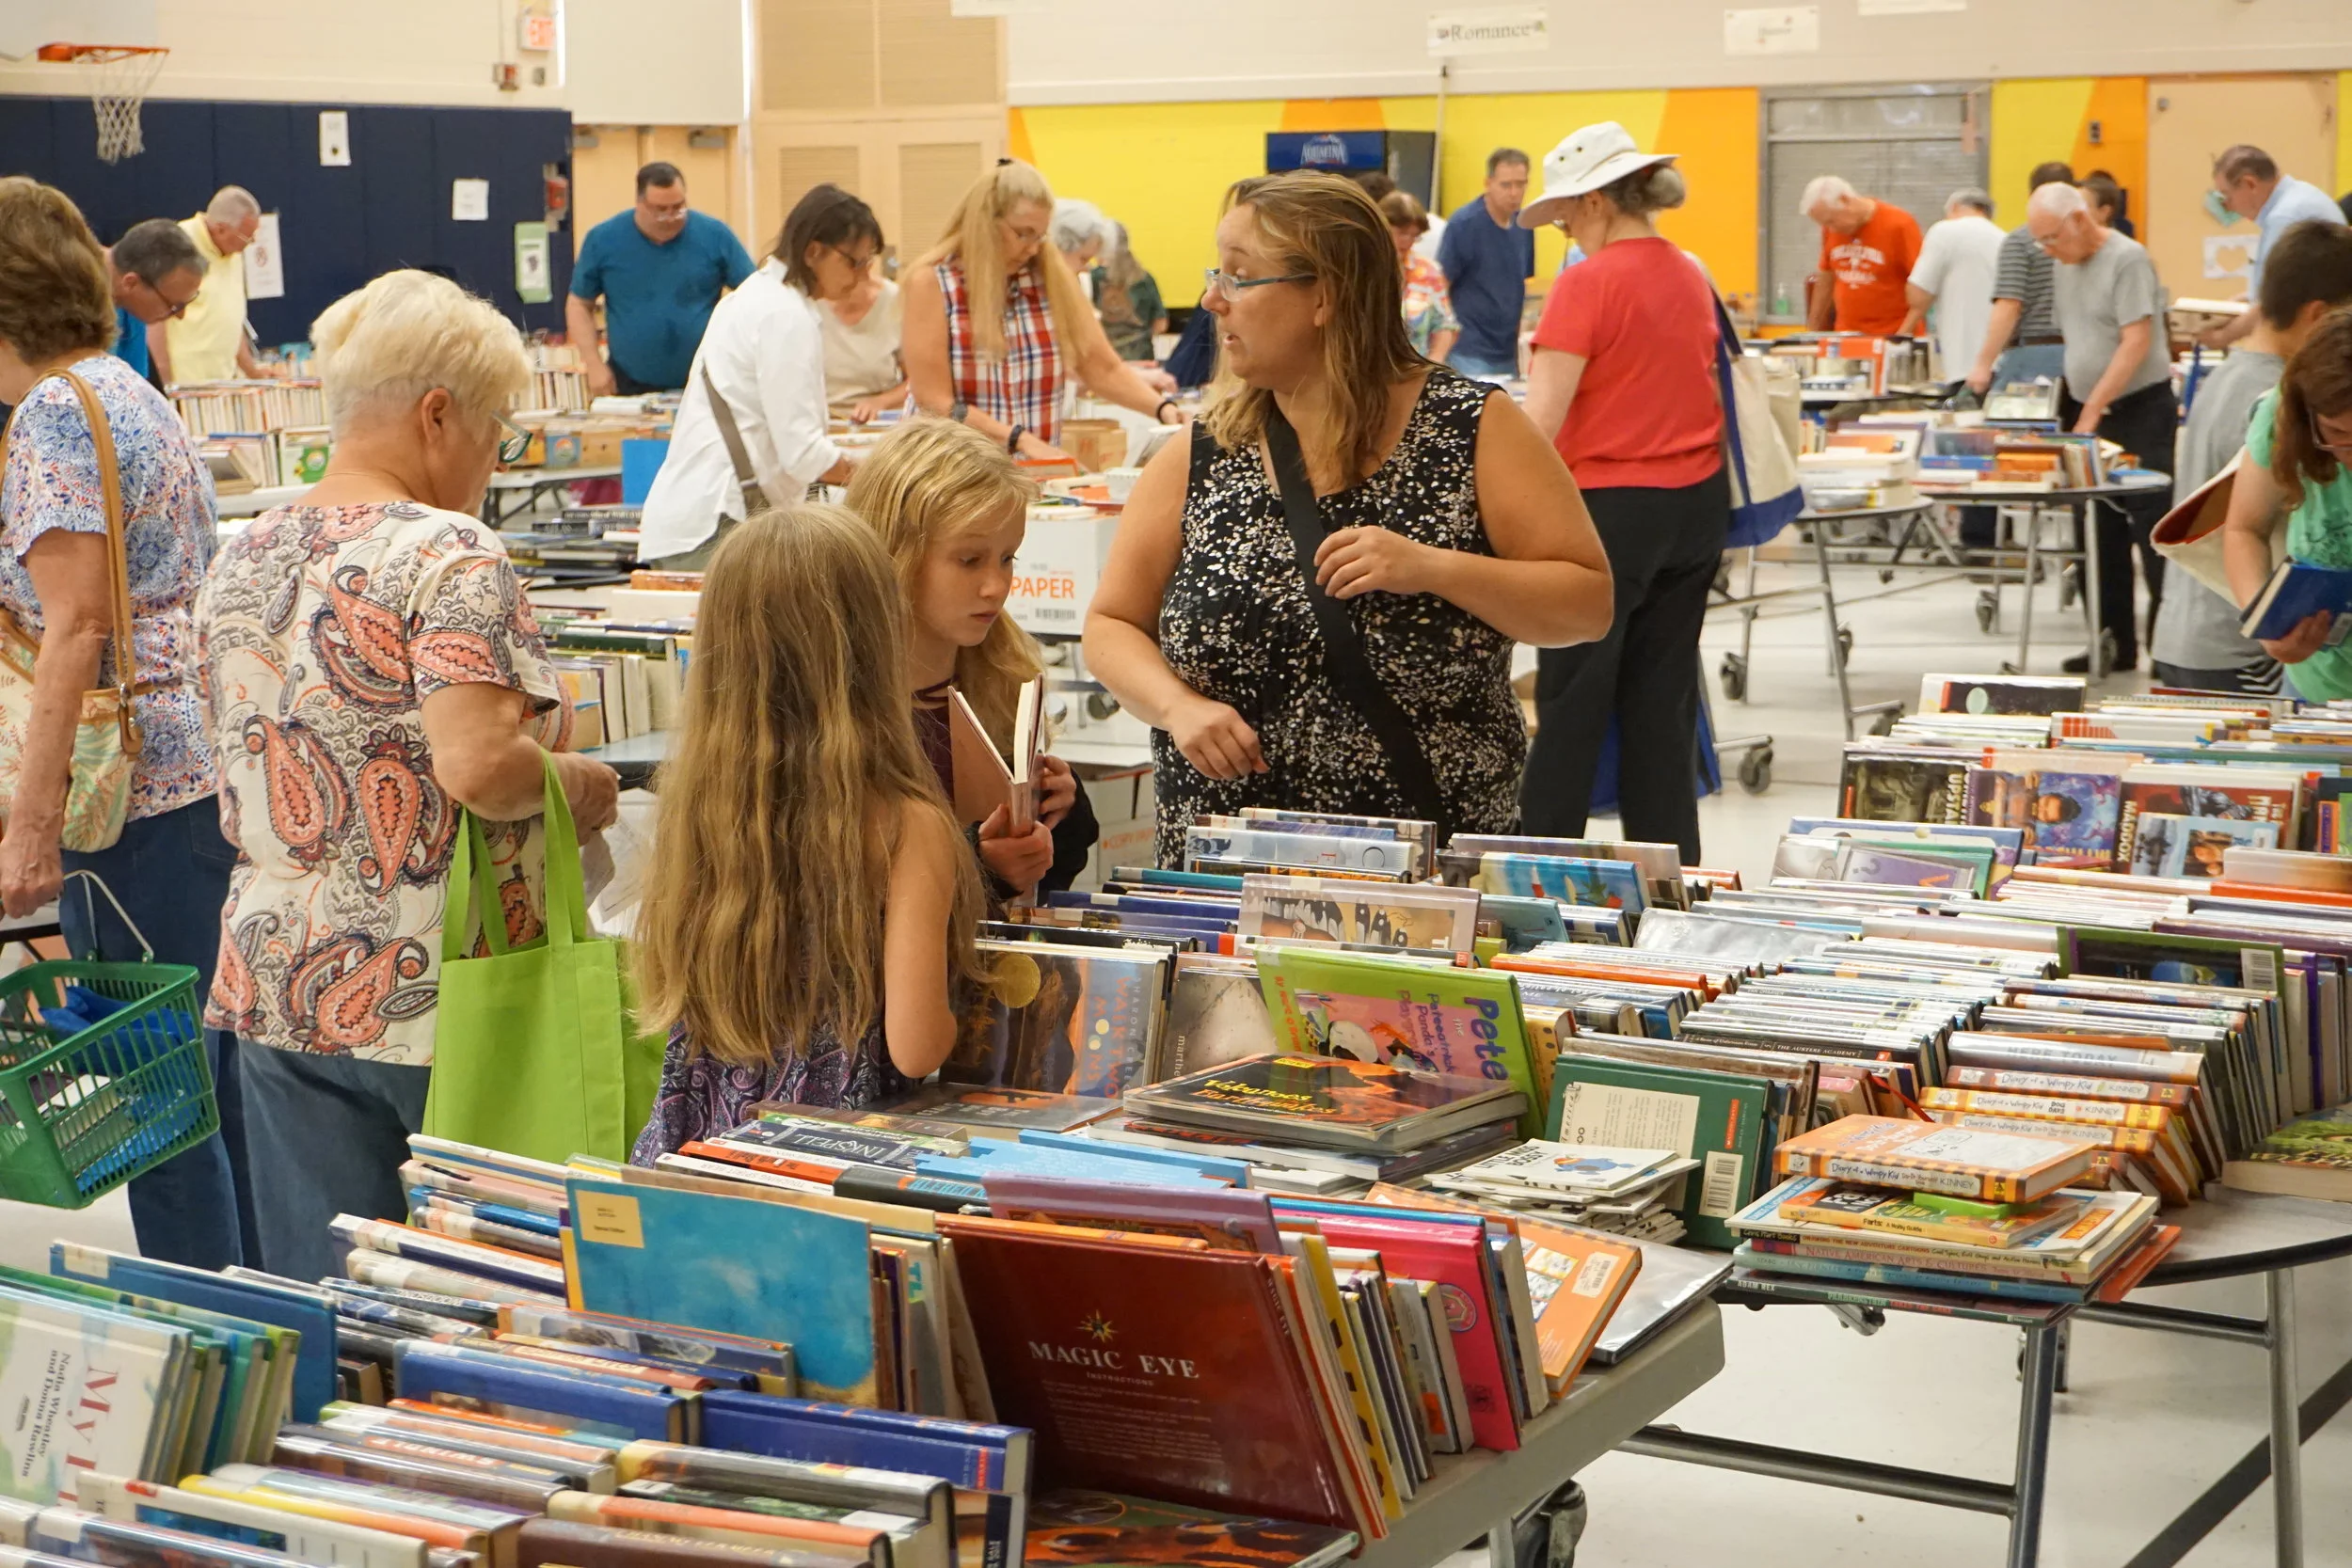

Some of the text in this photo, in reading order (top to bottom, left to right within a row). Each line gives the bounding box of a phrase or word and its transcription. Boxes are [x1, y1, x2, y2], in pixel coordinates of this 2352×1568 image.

[1451, 23, 1531, 41] Romance
[1009, 576, 1075, 599] PAPER
[2117, 800, 2137, 863] MADDOX
[1415, 1005, 1436, 1056] Panda's
[1452, 1018, 1463, 1037] the
[1463, 997, 1510, 1081] Pete
[1174, 1036, 1185, 1077] marthe
[1822, 1049, 1856, 1057] ACADEMY
[2007, 1047, 2118, 1068] HERE TODAY
[1104, 1048, 1123, 1099] TWO
[2001, 1073, 2028, 1085] Diary
[2046, 1078, 2075, 1089] Wimpy
[2076, 1079, 2093, 1091] Kid
[2108, 1084, 2143, 1094] KINNEY
[1204, 1079, 1313, 1101] Volcanoes
[1977, 1097, 1996, 1106] Diary
[2010, 1099, 2031, 1109] Wimpy
[2032, 1101, 2044, 1110] Kid
[2084, 1105, 2120, 1116] KINNEY
[1964, 1118, 1984, 1128] Diary
[1997, 1122, 2020, 1132] Wimpy
[2073, 1129, 2107, 1139] KINNEY
[794, 1133, 888, 1159] INKSPELL
[701, 1163, 806, 1189] TOUCHING SPIRIT BEAR
[1831, 1163, 1851, 1174] Diary
[1865, 1169, 1887, 1180] Wimpy
[1887, 1170, 1899, 1180] Kid
[1940, 1178, 1975, 1189] KINNEY
[1863, 1217, 1883, 1227] Farts:
[1806, 1246, 1838, 1259] NATIVE
[1844, 1248, 1895, 1264] AMERICAN
[1860, 1240, 1896, 1250] ADVENTURE
[1897, 1243, 1930, 1254] CARTOONS
[1737, 1280, 1775, 1291] ADAM REX
[47, 1350, 58, 1374] and
[1028, 1340, 1200, 1380] MAGIC EYE
[1086, 1371, 1154, 1386] INSTRUCTIONS
[36, 1378, 54, 1420] Donna
[38, 1353, 72, 1458] Nadia Wheatley
[66, 1364, 120, 1446] My
[22, 1424, 43, 1478] Rawlins
[370, 1437, 496, 1466] SWINDLE
